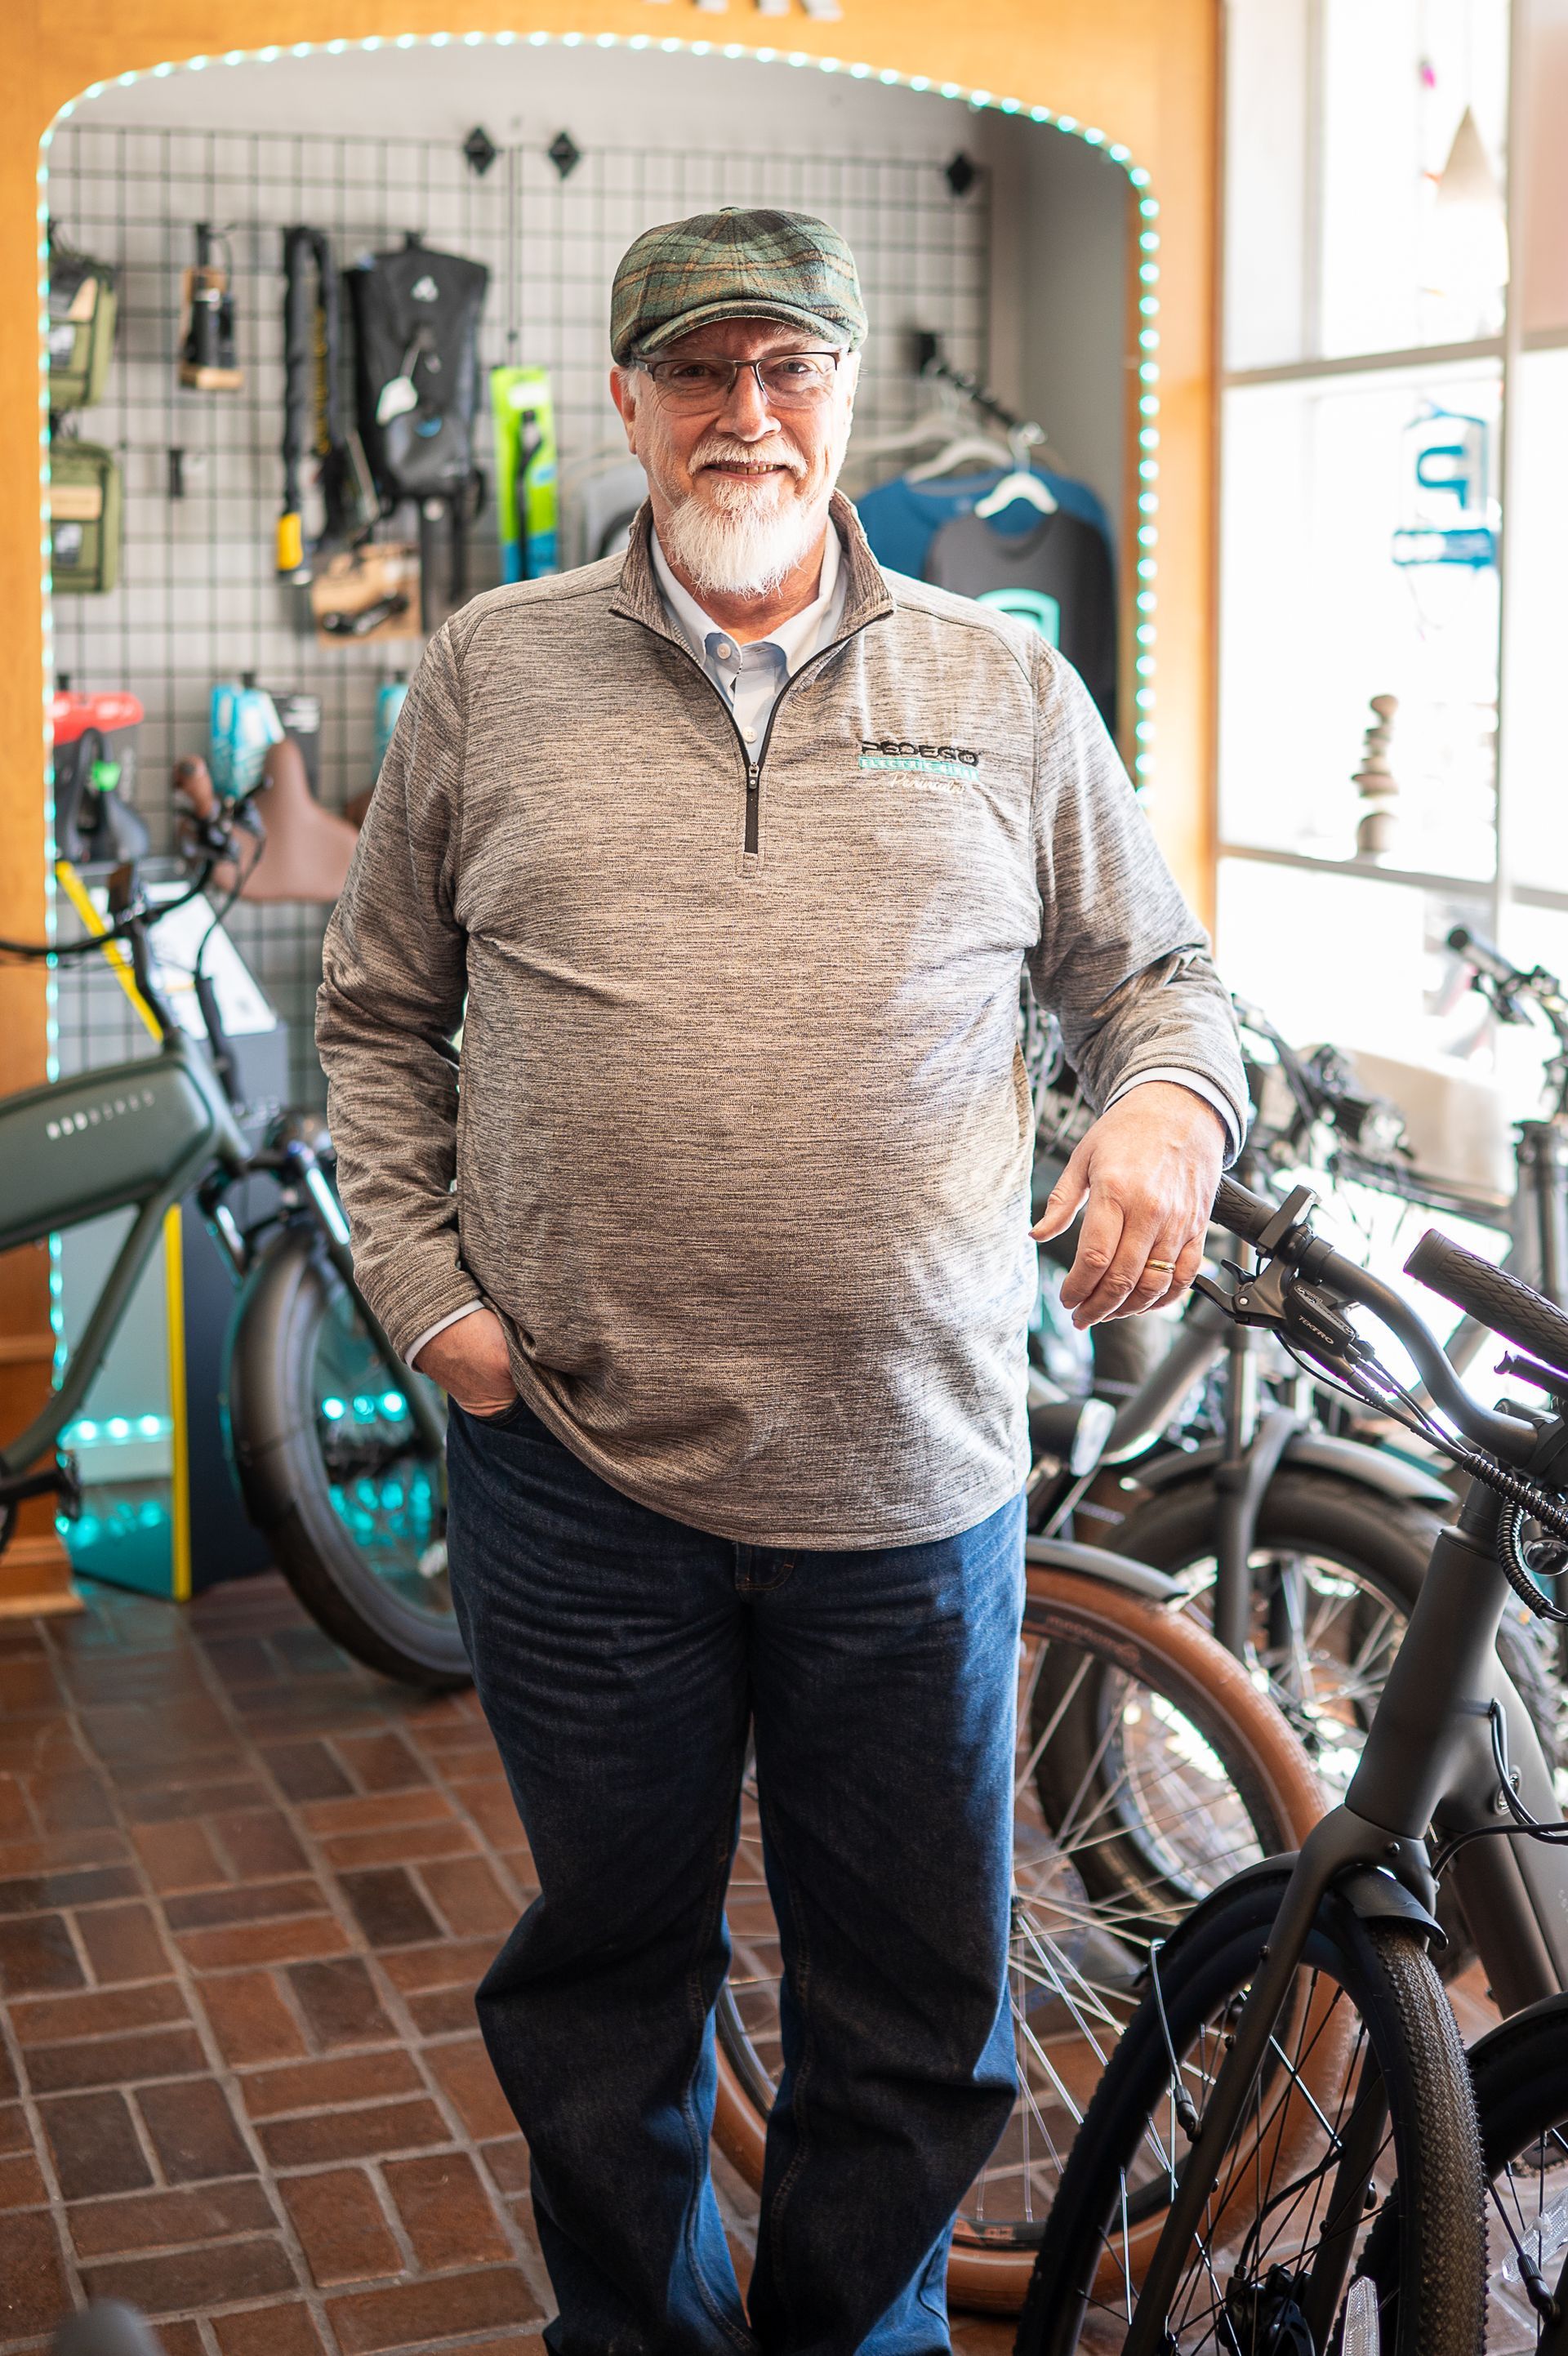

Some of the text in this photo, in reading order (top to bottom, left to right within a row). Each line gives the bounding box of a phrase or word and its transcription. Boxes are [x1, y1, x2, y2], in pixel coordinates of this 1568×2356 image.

[861, 759, 933, 771] ELECTRIC
[862, 741, 979, 767] PEDEGO
[1298, 1315, 1334, 1345] TEKTRO
